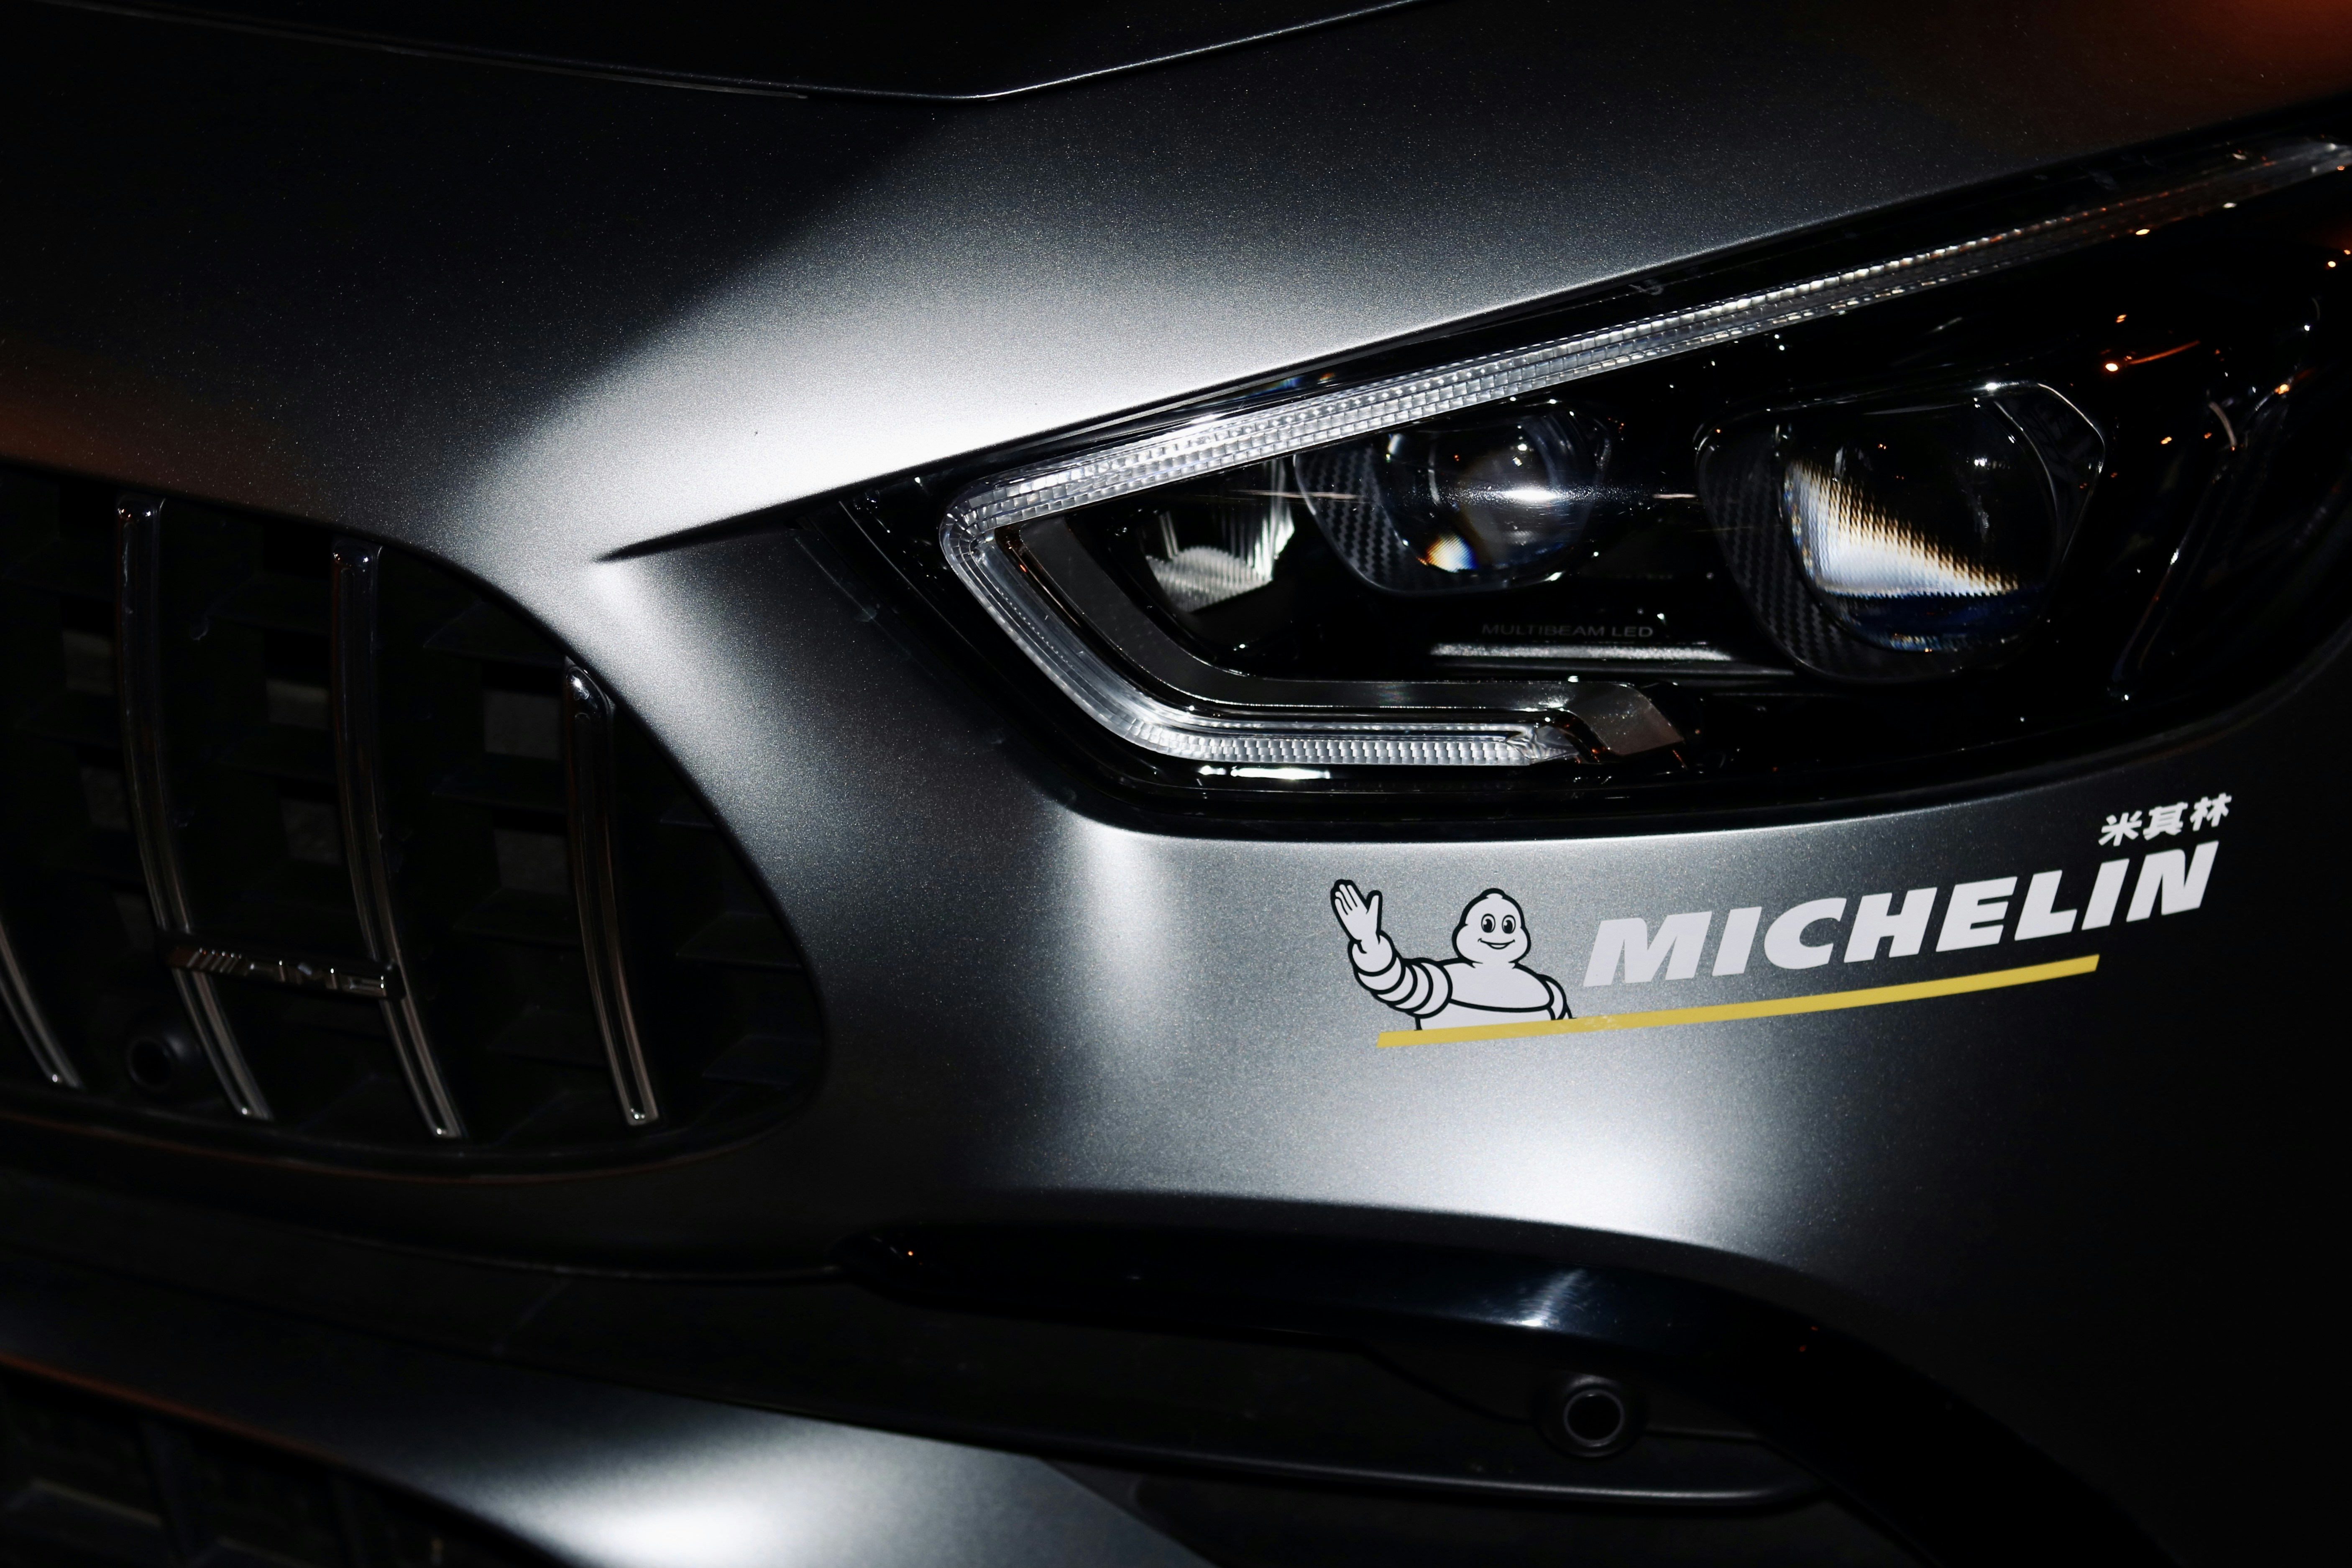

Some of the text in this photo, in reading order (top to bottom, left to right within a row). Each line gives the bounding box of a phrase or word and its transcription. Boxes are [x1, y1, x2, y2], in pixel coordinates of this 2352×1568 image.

[1482, 624, 1654, 638] MULTIBEAM LED
[2099, 793, 2232, 846] 米其林
[1583, 842, 2218, 987] MICHELIN
